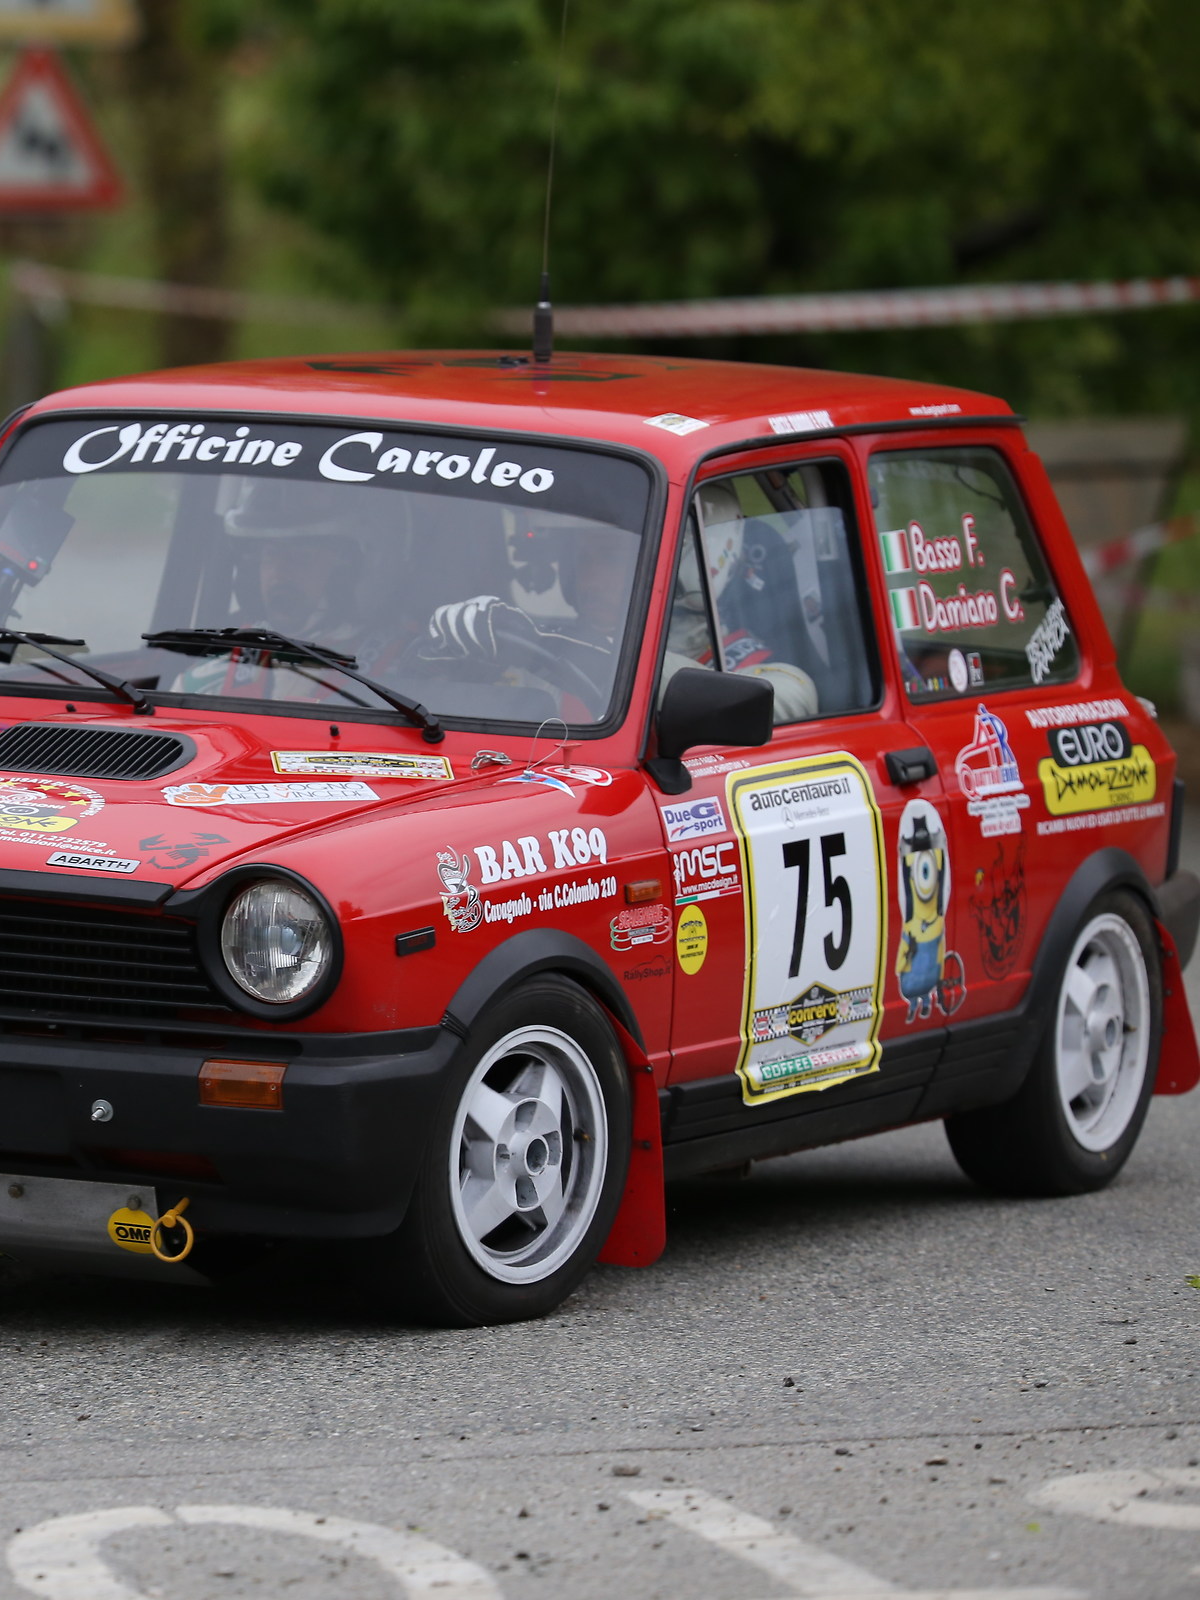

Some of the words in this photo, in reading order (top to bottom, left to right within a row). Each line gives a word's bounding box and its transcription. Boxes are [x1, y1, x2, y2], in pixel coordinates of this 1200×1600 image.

[63, 423, 302, 474] Officine
[318, 432, 555, 493] Caroleo
[910, 521, 962, 574] Basso
[962, 513, 985, 567] F.
[917, 580, 998, 634] Damiano
[1000, 568, 1025, 622] C.
[1057, 722, 1124, 766] EURO
[12, 777, 53, 785] USATI
[232, 784, 269, 792] UN
[274, 782, 364, 791] SOGNO
[0, 829, 17, 837] Tel.
[693, 815, 723, 832] sport
[54, 854, 131, 871] ABARTH
[473, 836, 547, 884] BAR
[548, 827, 607, 869] K89
[484, 892, 532, 924] Cavagnolo
[538, 888, 554, 911] via
[600, 876, 617, 898] 210
[782, 832, 852, 979] 75
[624, 966, 671, 981] RallyShop.it
[789, 1002, 837, 1025] conrero
[761, 1056, 811, 1079] COFFEE
[811, 1046, 860, 1067] SERVICE
[115, 1226, 151, 1242] OMP
